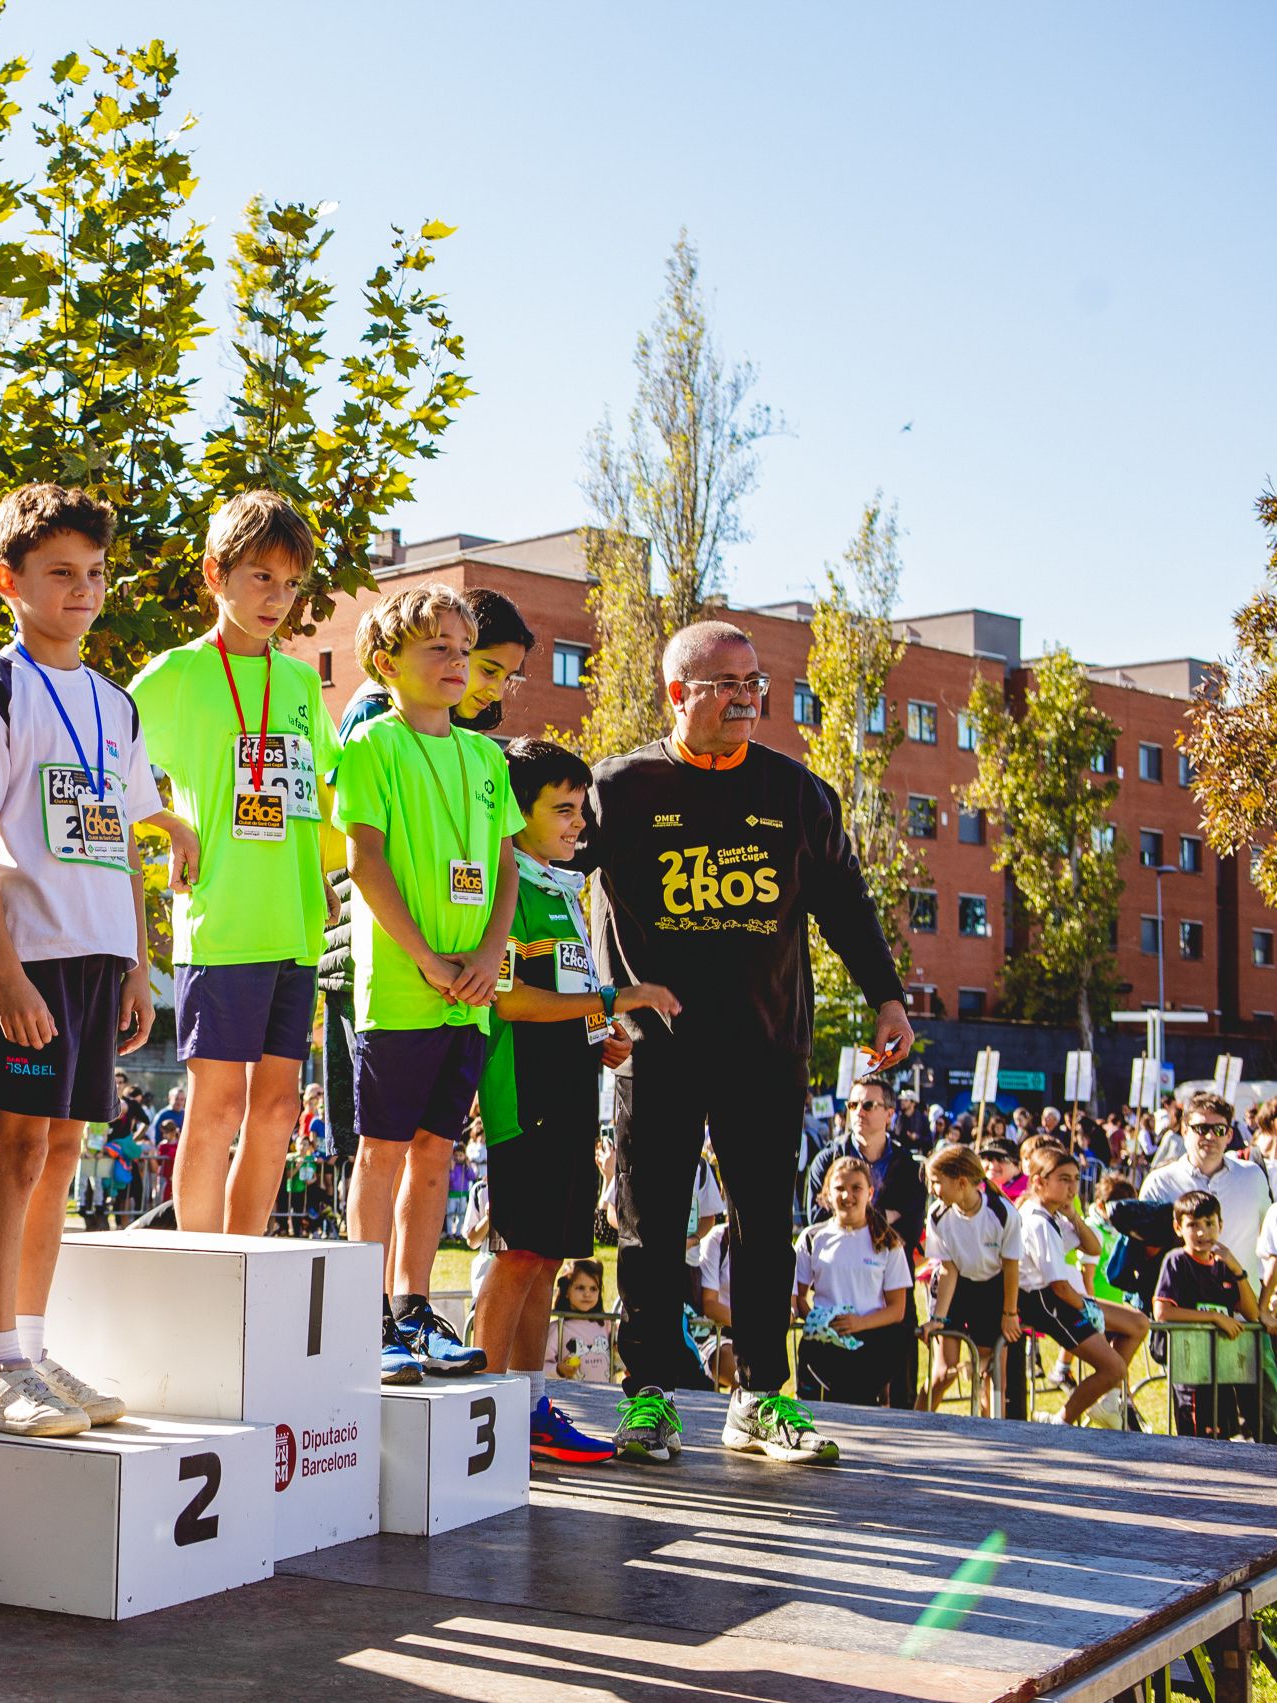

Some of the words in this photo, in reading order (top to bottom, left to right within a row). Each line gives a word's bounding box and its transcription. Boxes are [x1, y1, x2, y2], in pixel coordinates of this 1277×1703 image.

[238, 805, 282, 822] CROS
[654, 814, 682, 823] OMET
[85, 816, 121, 836] CROS
[717, 847, 746, 858] Ciutat
[747, 844, 759, 853] de
[718, 855, 741, 866] Sant
[741, 851, 769, 862] Cugat
[454, 876, 482, 890] CROS
[663, 867, 780, 915] CROS
[562, 953, 588, 970] CROS
[302, 1421, 358, 1453] Diputació
[468, 1396, 497, 1476] 3
[302, 1451, 357, 1477] Barcelona
[174, 1451, 222, 1547] 2
